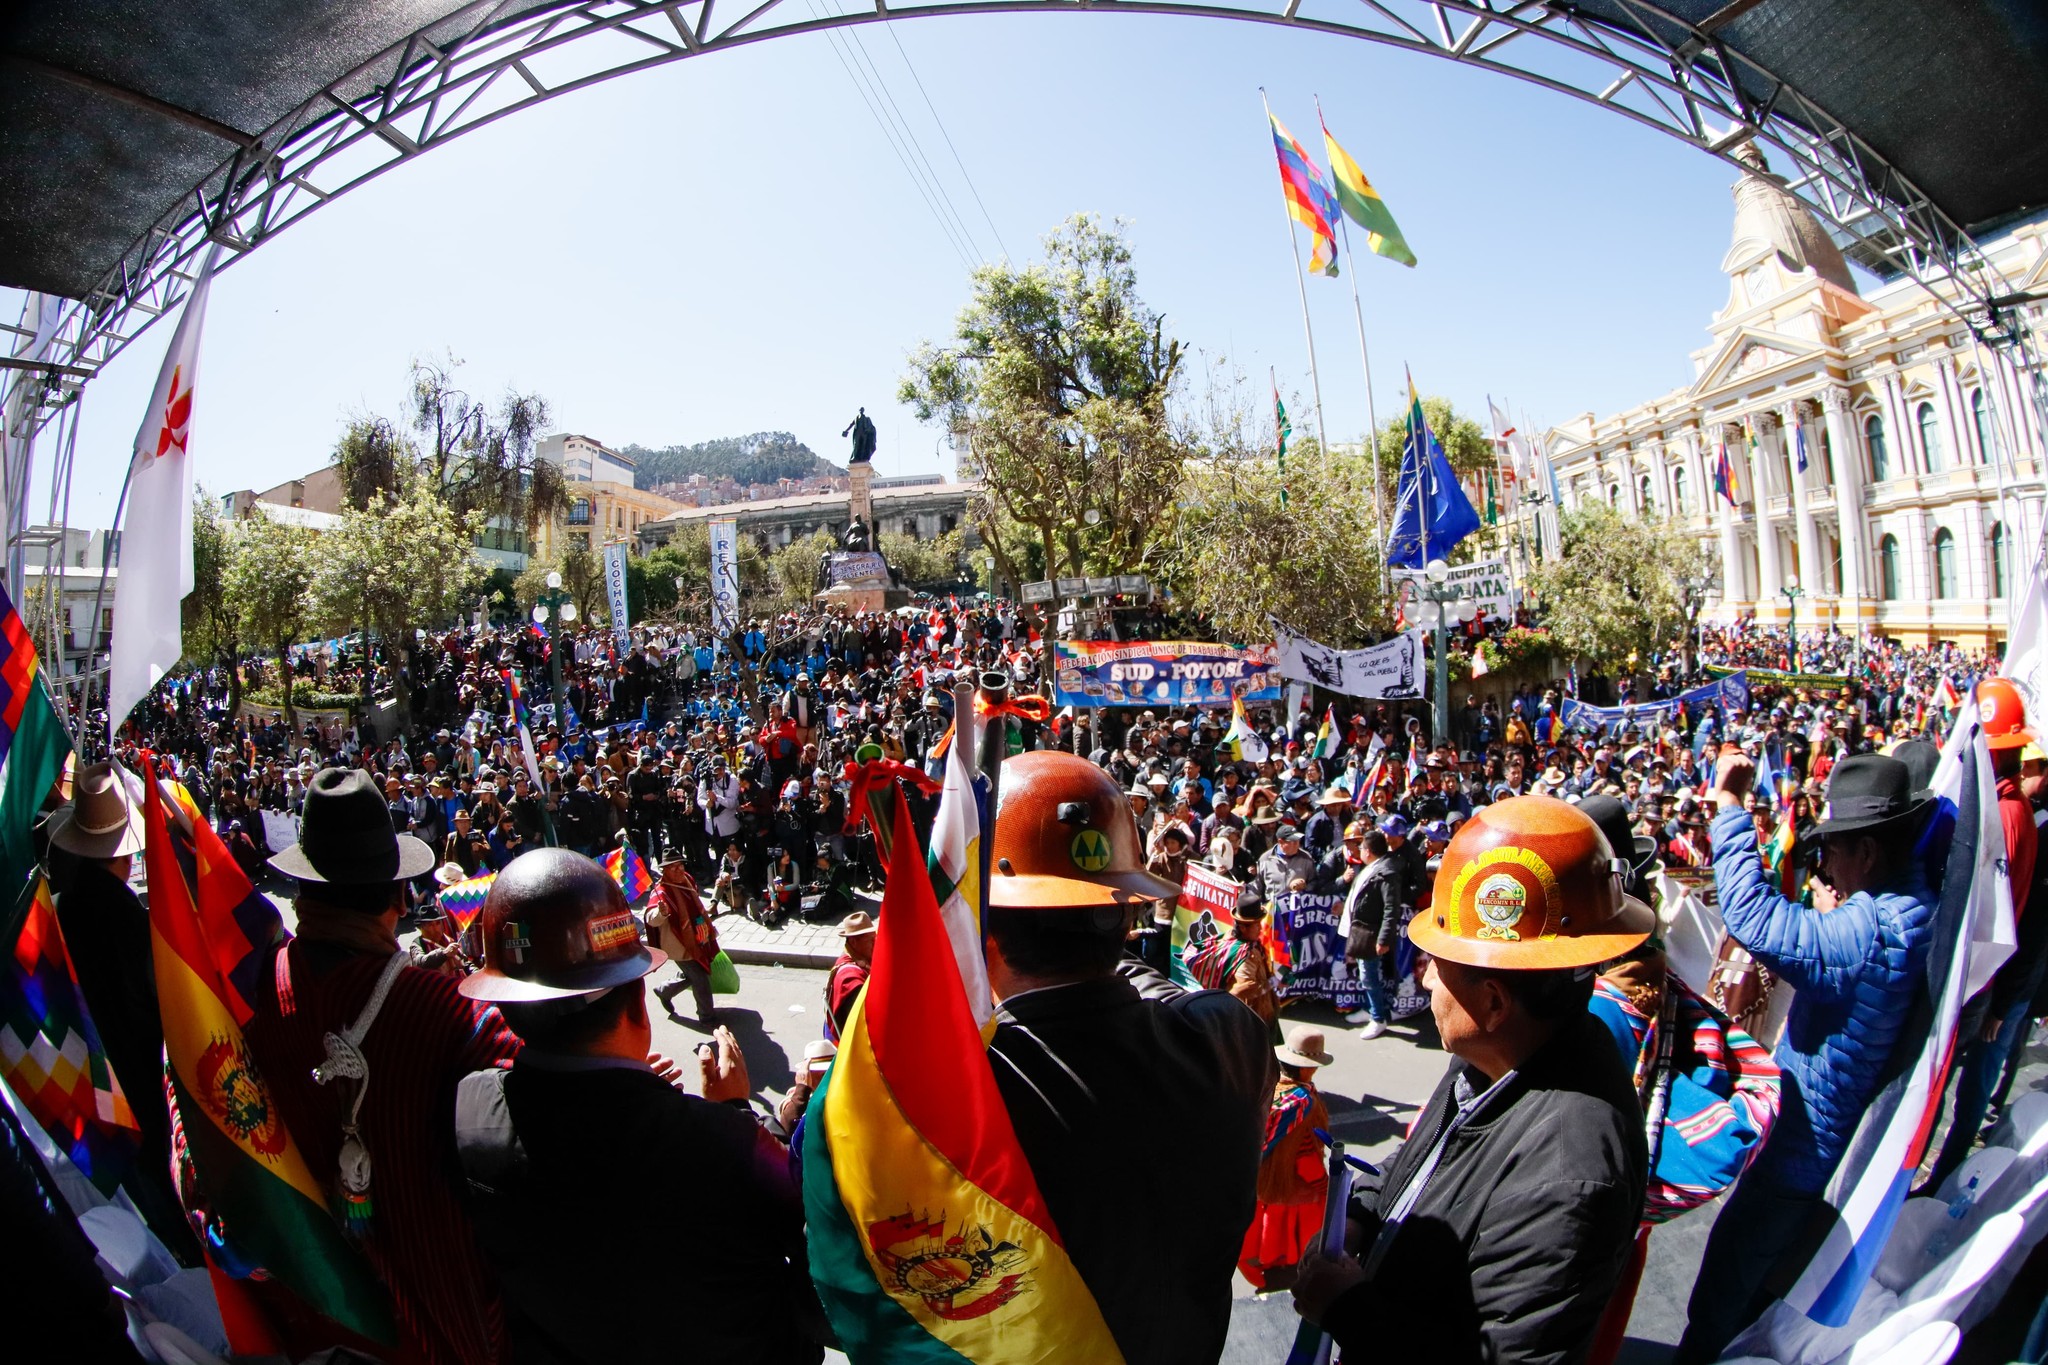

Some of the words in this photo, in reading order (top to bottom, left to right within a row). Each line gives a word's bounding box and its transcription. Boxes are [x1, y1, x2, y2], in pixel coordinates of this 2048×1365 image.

[1488, 563, 1503, 576] DE
[1060, 648, 1112, 671] FEDERACIÓN
[1113, 646, 1151, 663] SINDICAL
[1177, 644, 1188, 655] DE
[1188, 645, 1241, 661] TRABAJADORES
[1111, 663, 1155, 682] SUD
[1171, 659, 1244, 680] POTOSÍ
[1377, 666, 1398, 676] PUEBLO
[1518, 849, 1556, 887] MINERAS
[1294, 913, 1305, 929] 5
[1306, 910, 1340, 926] REG
[923, 1252, 985, 1289] BOLIVIA
